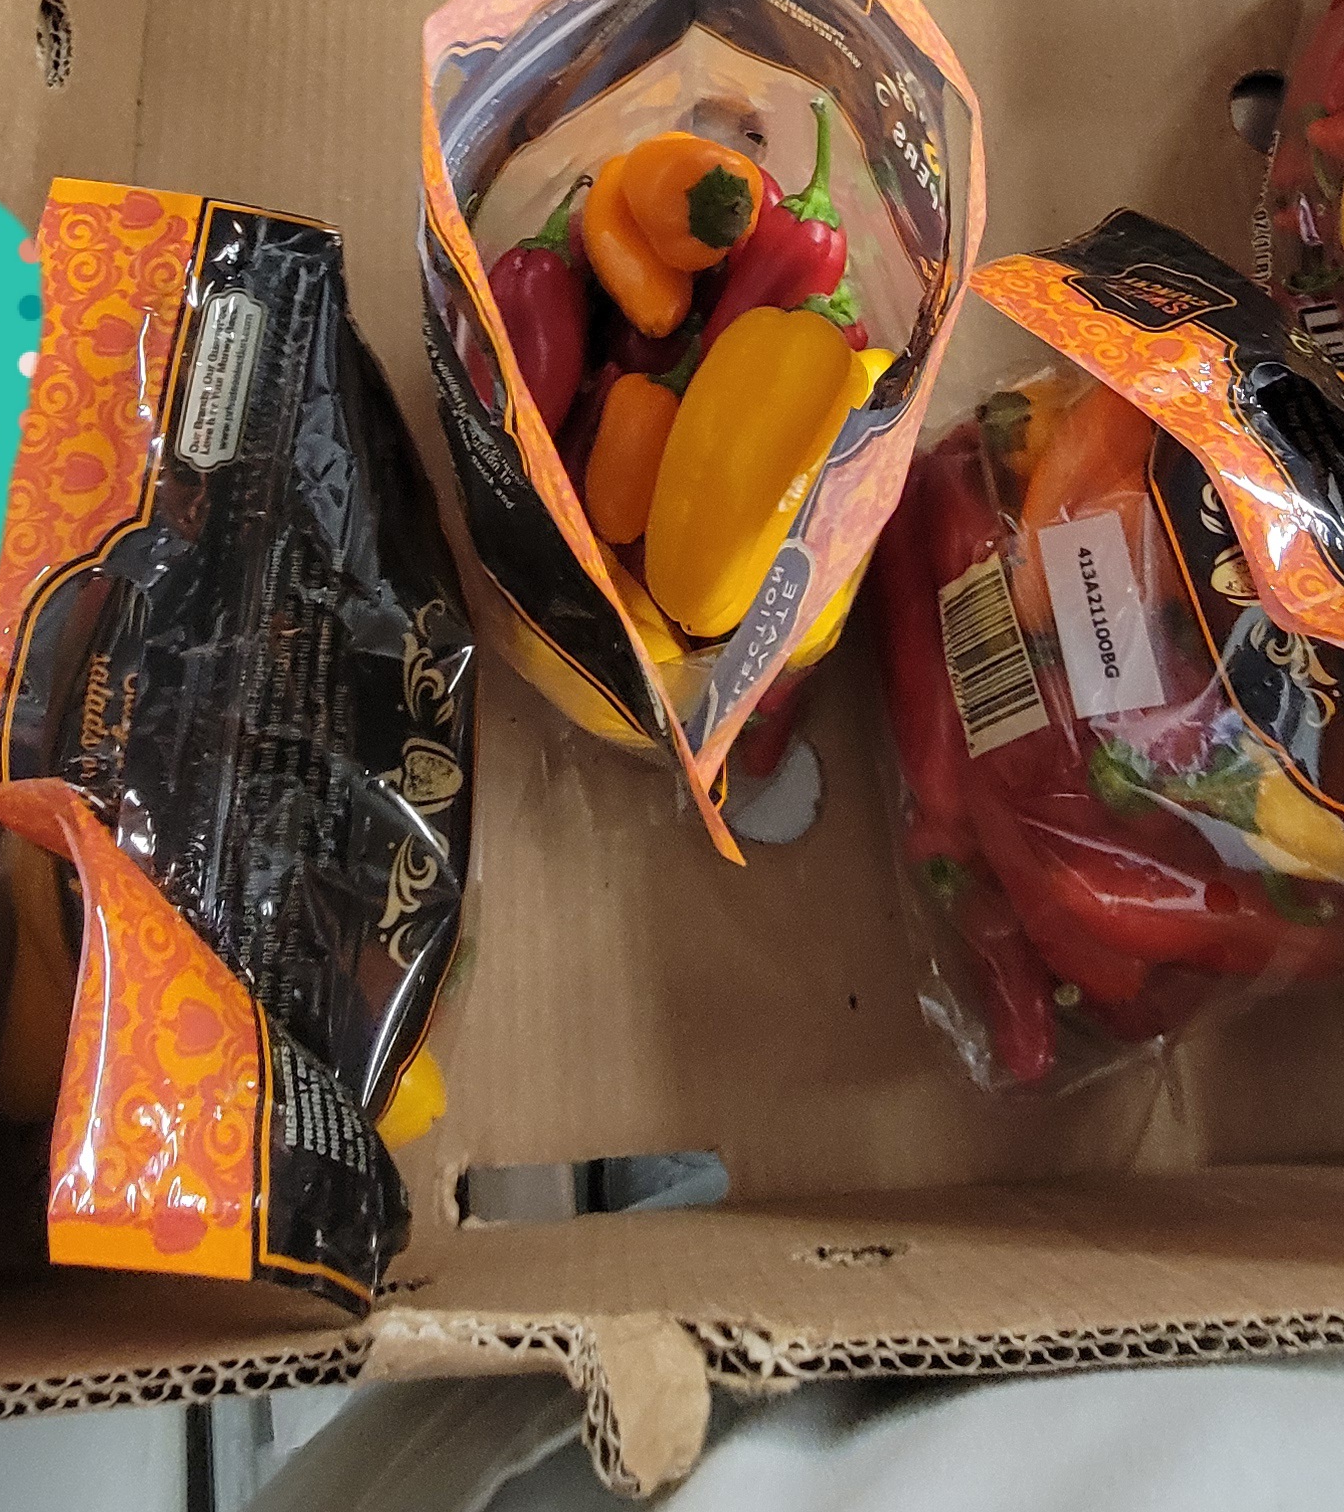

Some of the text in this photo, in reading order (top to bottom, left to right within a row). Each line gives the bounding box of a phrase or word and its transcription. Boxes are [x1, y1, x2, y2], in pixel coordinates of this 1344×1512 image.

[202, 364, 215, 385] Our
[492, 486, 516, 511] and
[1076, 545, 1120, 679] 413A21100BG
[259, 923, 277, 964] make
